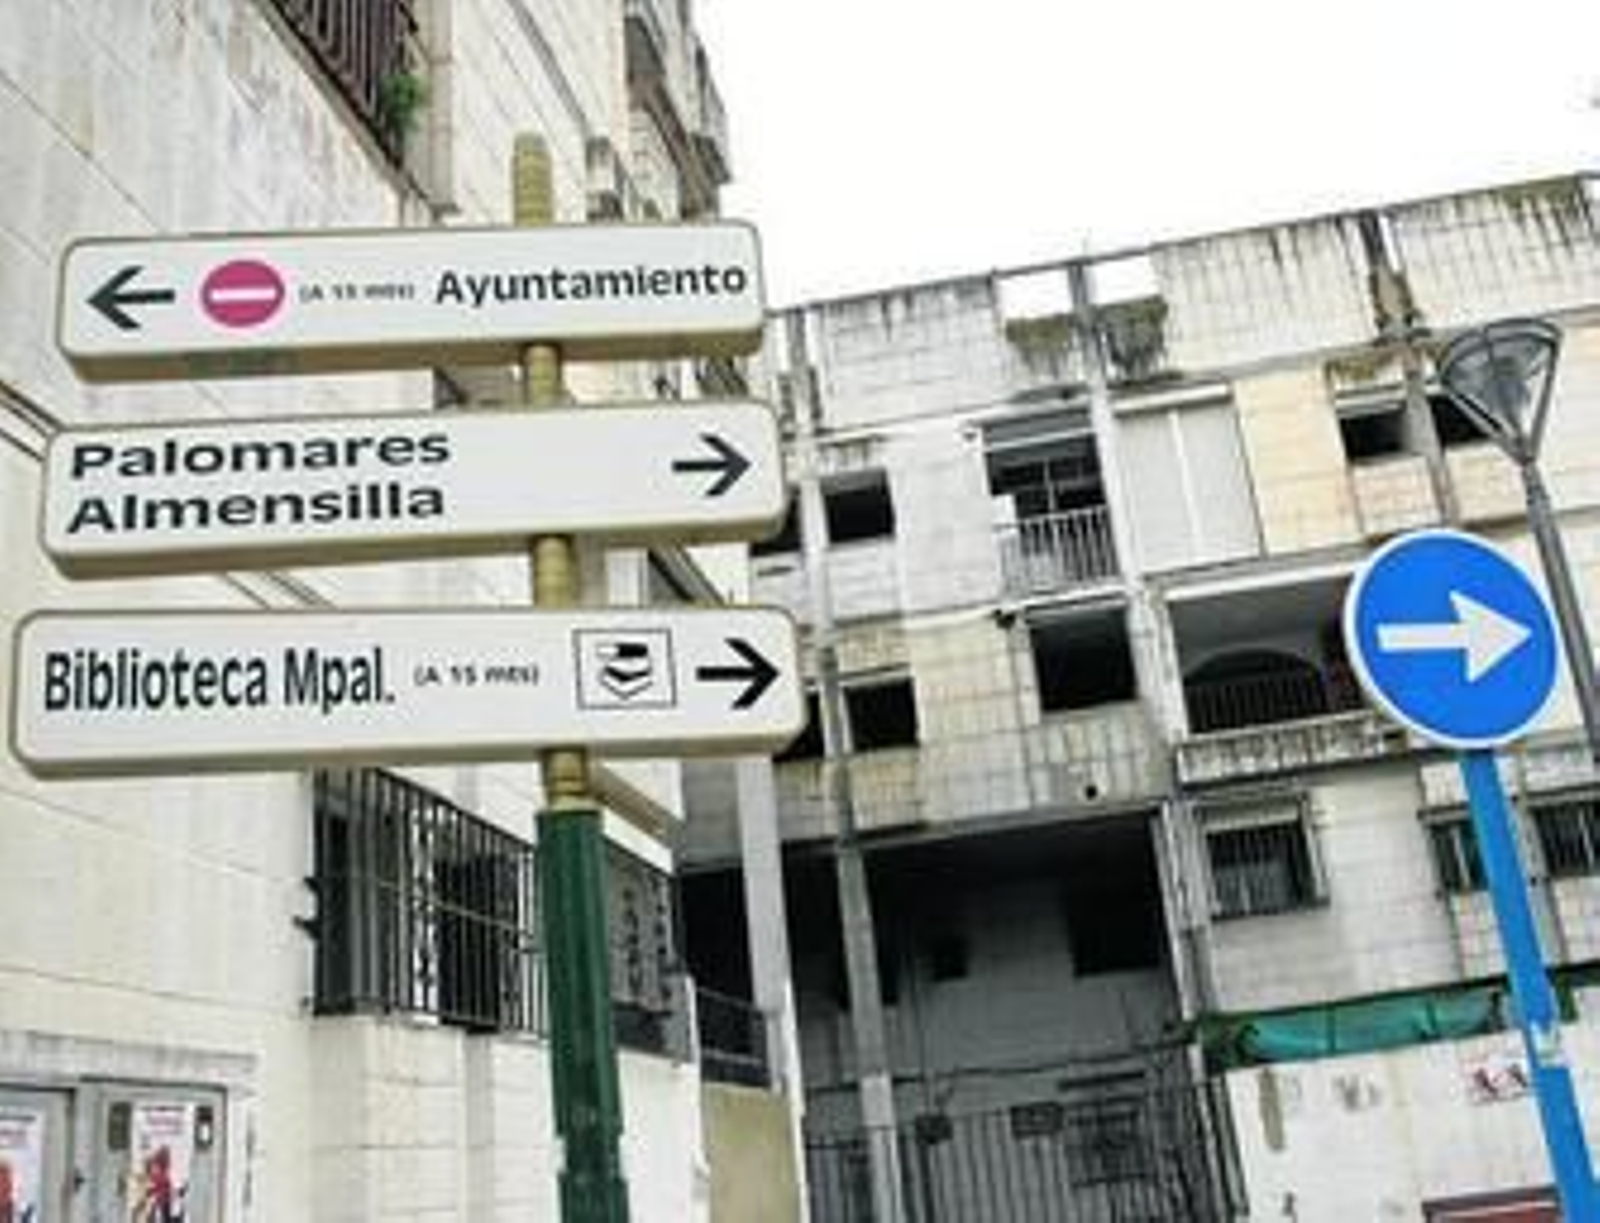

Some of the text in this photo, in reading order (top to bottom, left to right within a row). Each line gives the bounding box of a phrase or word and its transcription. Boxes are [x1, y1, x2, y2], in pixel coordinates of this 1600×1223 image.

[435, 264, 747, 308] Ayuntamiento
[70, 433, 450, 479] Palomares
[66, 481, 445, 534] Almensilla
[44, 645, 540, 715] Biblioteca Mpal. (A 15 mts)
